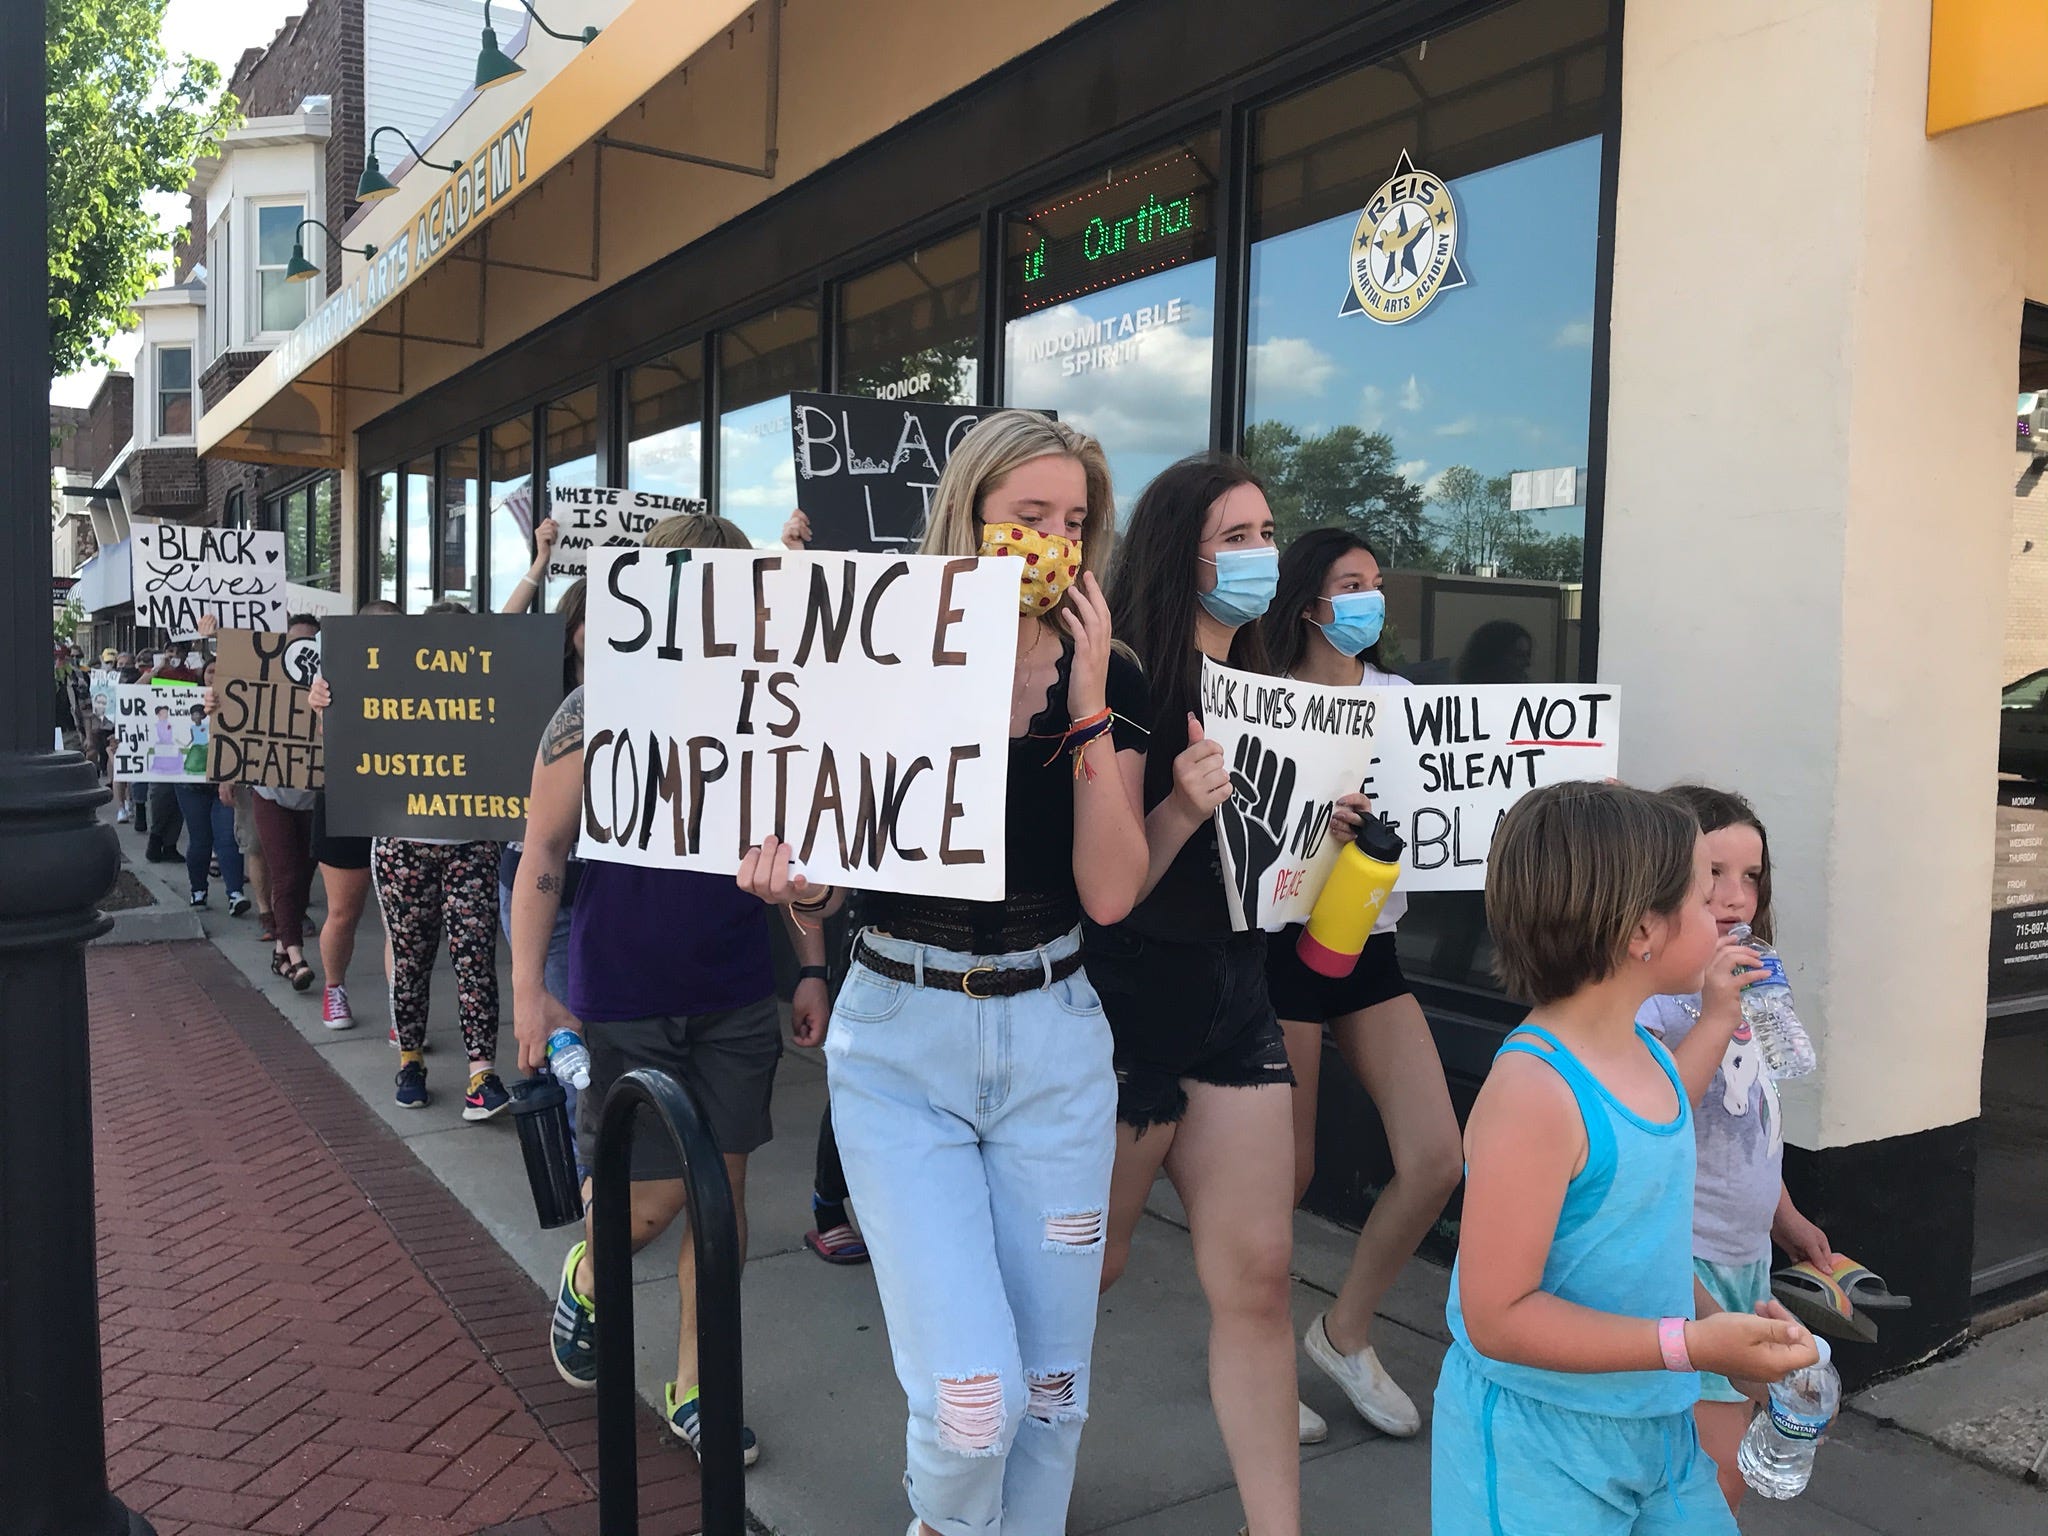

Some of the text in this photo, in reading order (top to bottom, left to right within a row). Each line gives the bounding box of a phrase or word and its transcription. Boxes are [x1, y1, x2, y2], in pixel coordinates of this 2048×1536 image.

[1368, 177, 1439, 226] REIS
[304, 276, 363, 358] MARTIAL
[366, 228, 411, 310] ARTS
[415, 105, 533, 272] ACADEMY
[1356, 233, 1450, 313] MARTIAL ARTS ACADEMY
[1027, 297, 1182, 378] INDOMITABLE SPIRIT
[876, 372, 931, 400] HONOR
[555, 486, 621, 505] WHITE
[634, 492, 706, 514] SILENCE
[1515, 468, 1574, 506] 414
[571, 508, 608, 529] IS
[158, 525, 257, 565] BLACK
[560, 534, 594, 550] AND
[145, 561, 278, 595] Lives
[150, 595, 271, 632] MATTER
[607, 548, 979, 667] SILENCE
[366, 646, 492, 674] I CAN'T
[119, 697, 148, 717] UR
[362, 697, 496, 724] BREATHE!
[736, 669, 800, 738] IS
[1201, 662, 1377, 739] BLACK LIVES MATTER
[1404, 693, 1612, 746] WILL NOT
[118, 723, 150, 753] Fight
[115, 754, 145, 775] IS
[355, 753, 467, 777] JUSTICE
[1418, 748, 1546, 793] SILENT
[406, 793, 529, 819] MATTERS!
[2011, 796, 2036, 806] MONDAY
[1289, 799, 1334, 861] NO
[2010, 822, 2036, 833] TUESDAY
[2009, 837, 2044, 848] WEDNESDAY
[2008, 853, 2039, 863] THURSDAY
[2006, 879, 2028, 889] FRIDAY
[2006, 893, 2035, 905] SATURDAY
[1774, 1415, 1818, 1434] MOUNTAIN
